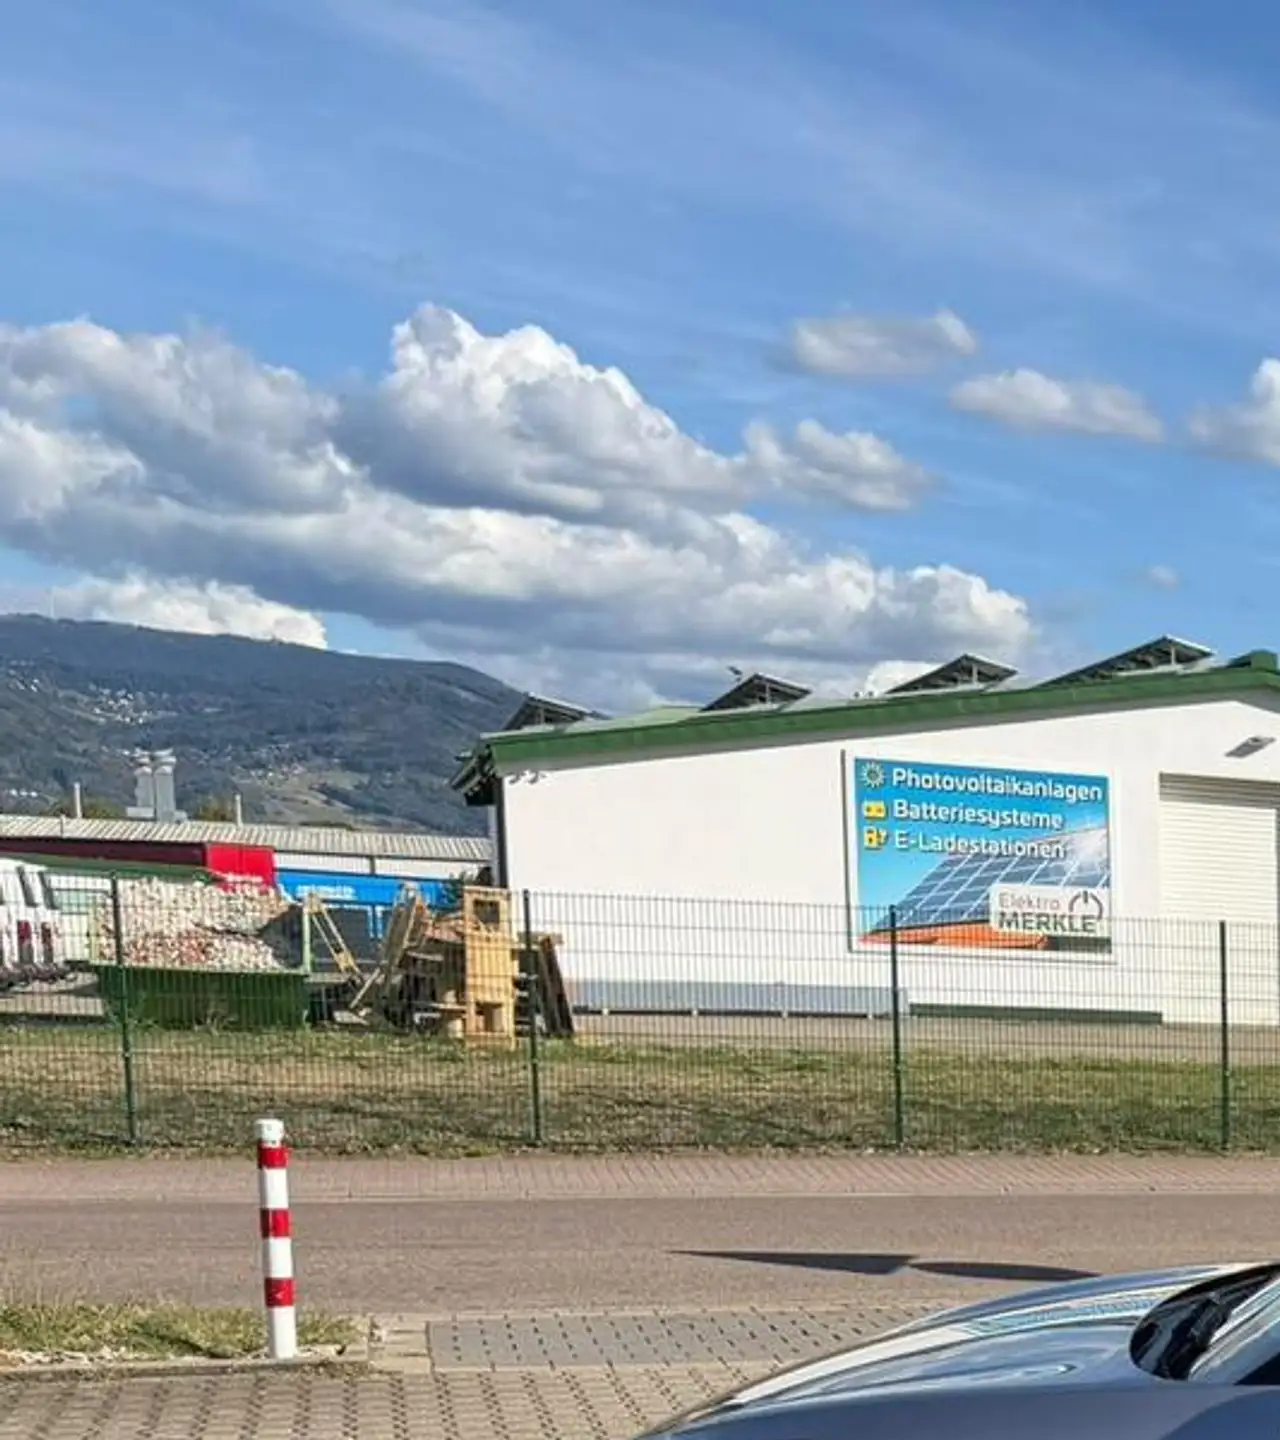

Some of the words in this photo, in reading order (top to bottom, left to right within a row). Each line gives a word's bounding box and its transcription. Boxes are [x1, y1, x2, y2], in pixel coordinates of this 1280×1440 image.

[892, 767, 1103, 802] Photovoltaikanlagen
[893, 800, 1063, 829] Batteriesysteme
[895, 830, 1065, 858] E-Ladestationen
[999, 891, 1061, 910] Elektro
[999, 911, 1098, 933] MERKLE
